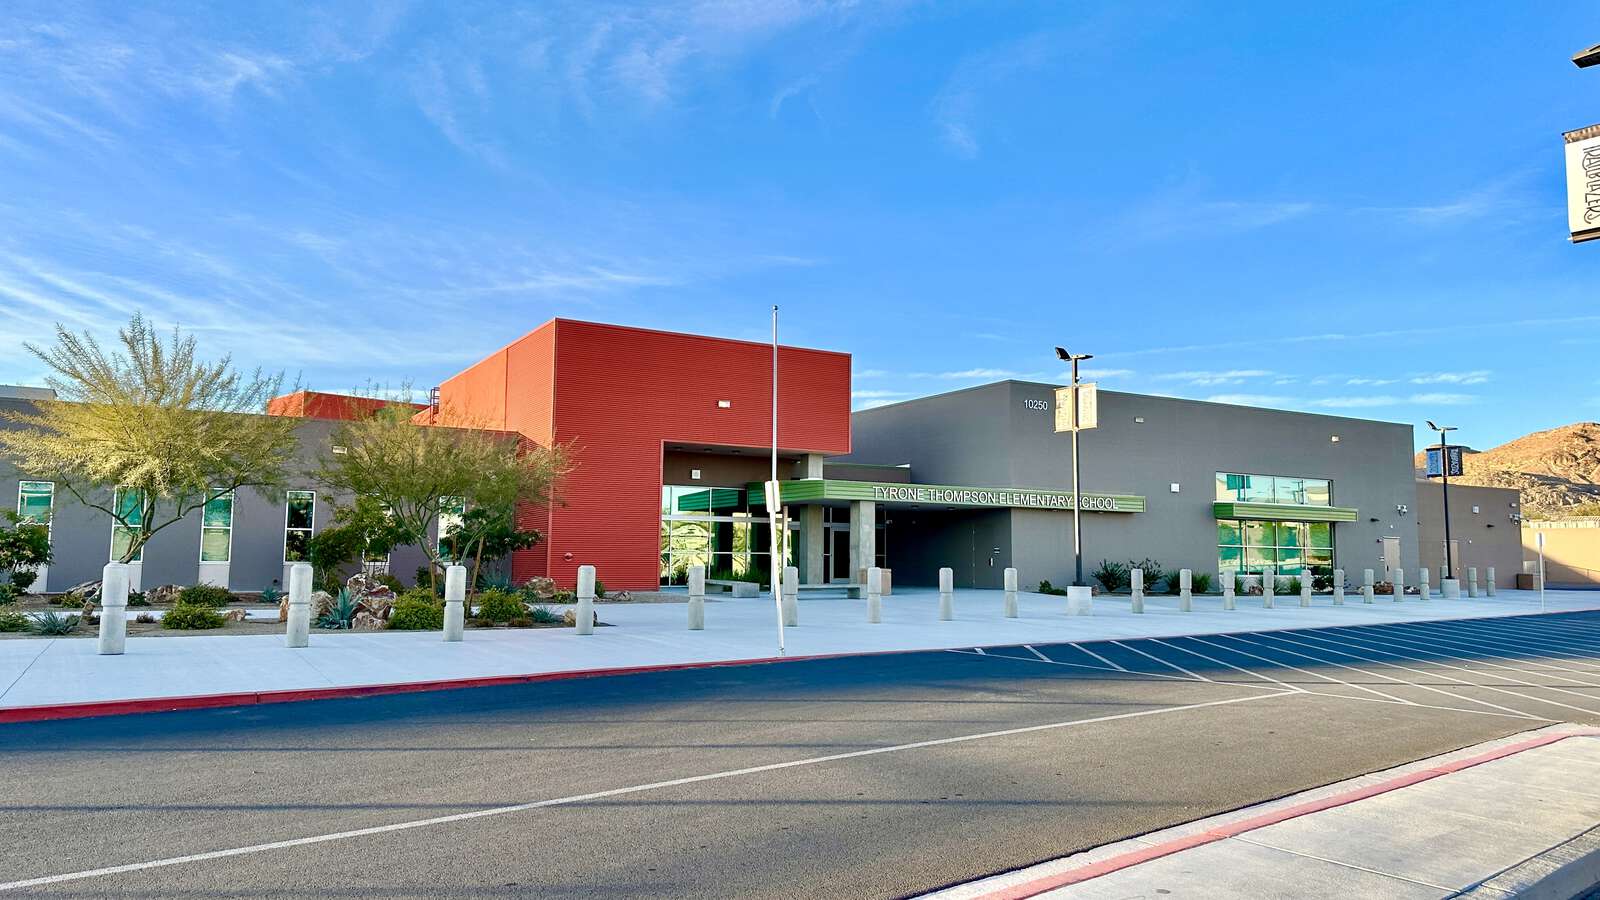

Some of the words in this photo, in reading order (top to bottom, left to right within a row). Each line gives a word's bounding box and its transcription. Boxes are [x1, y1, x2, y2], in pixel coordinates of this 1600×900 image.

[1024, 399, 1048, 411] 10250
[872, 486, 925, 501] TYRONE
[928, 488, 996, 504] THOMPSON
[999, 492, 1073, 507] ELEMENTARY
[1080, 496, 1119, 510] CHOOL
